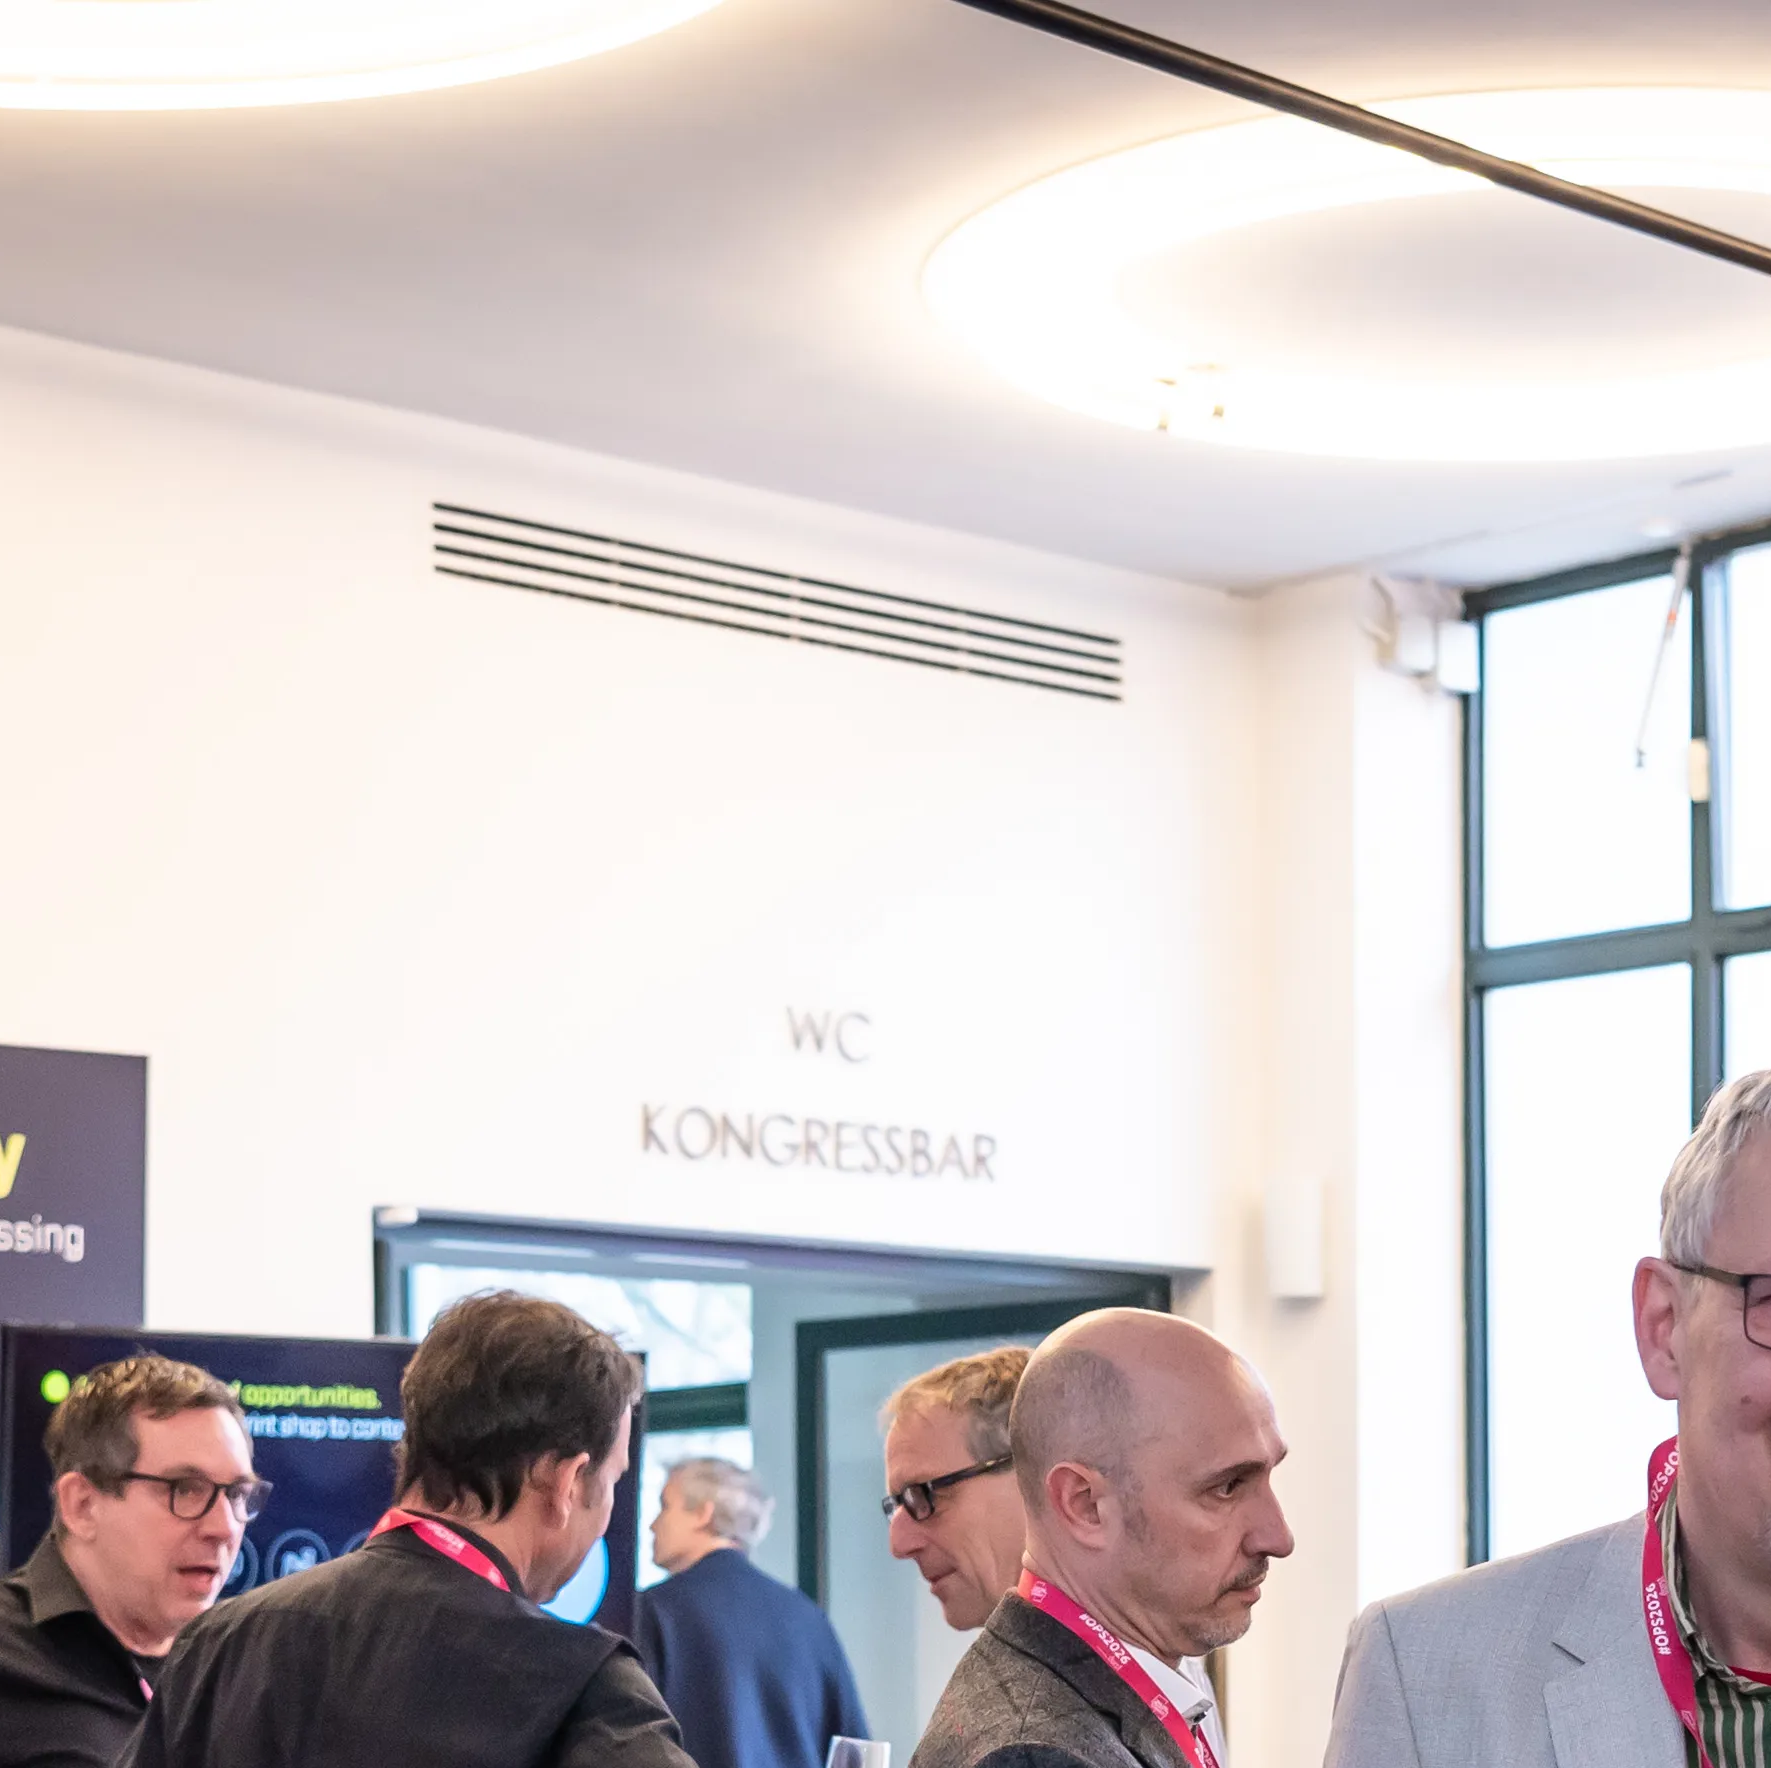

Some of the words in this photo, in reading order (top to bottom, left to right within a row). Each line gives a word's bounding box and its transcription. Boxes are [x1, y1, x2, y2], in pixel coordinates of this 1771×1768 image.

[785, 1005, 872, 1064] WC
[641, 1102, 998, 1182] KONGRESSBAR
[1078, 1613, 1132, 1665] #OPS2026
[1645, 1582, 1671, 1656] #OPS2026
